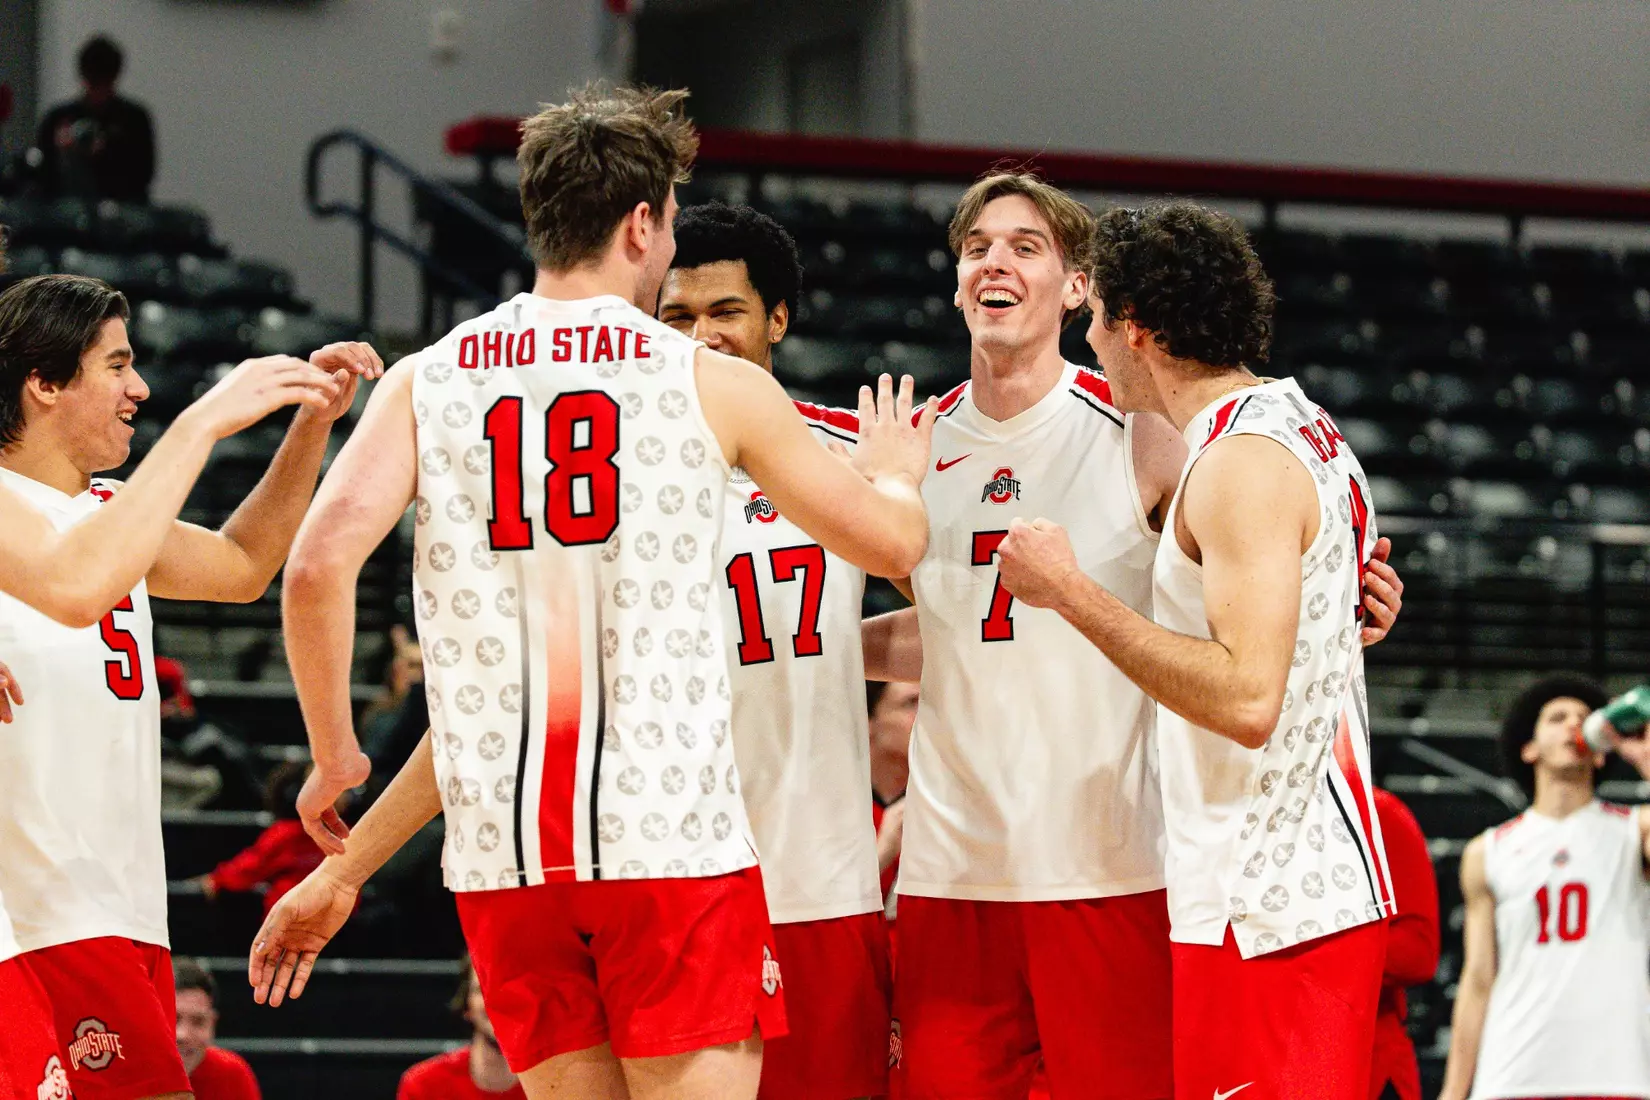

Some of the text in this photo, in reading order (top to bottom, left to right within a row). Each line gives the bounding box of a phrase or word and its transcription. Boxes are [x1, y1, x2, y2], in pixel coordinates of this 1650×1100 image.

[458, 325, 651, 369] OHIO STATE
[483, 389, 621, 551] 18
[725, 543, 826, 666] 17
[971, 529, 1015, 643] 7
[99, 593, 144, 700] 5
[1534, 882, 1589, 945] 10
[87, 1031, 126, 1060] STATE
